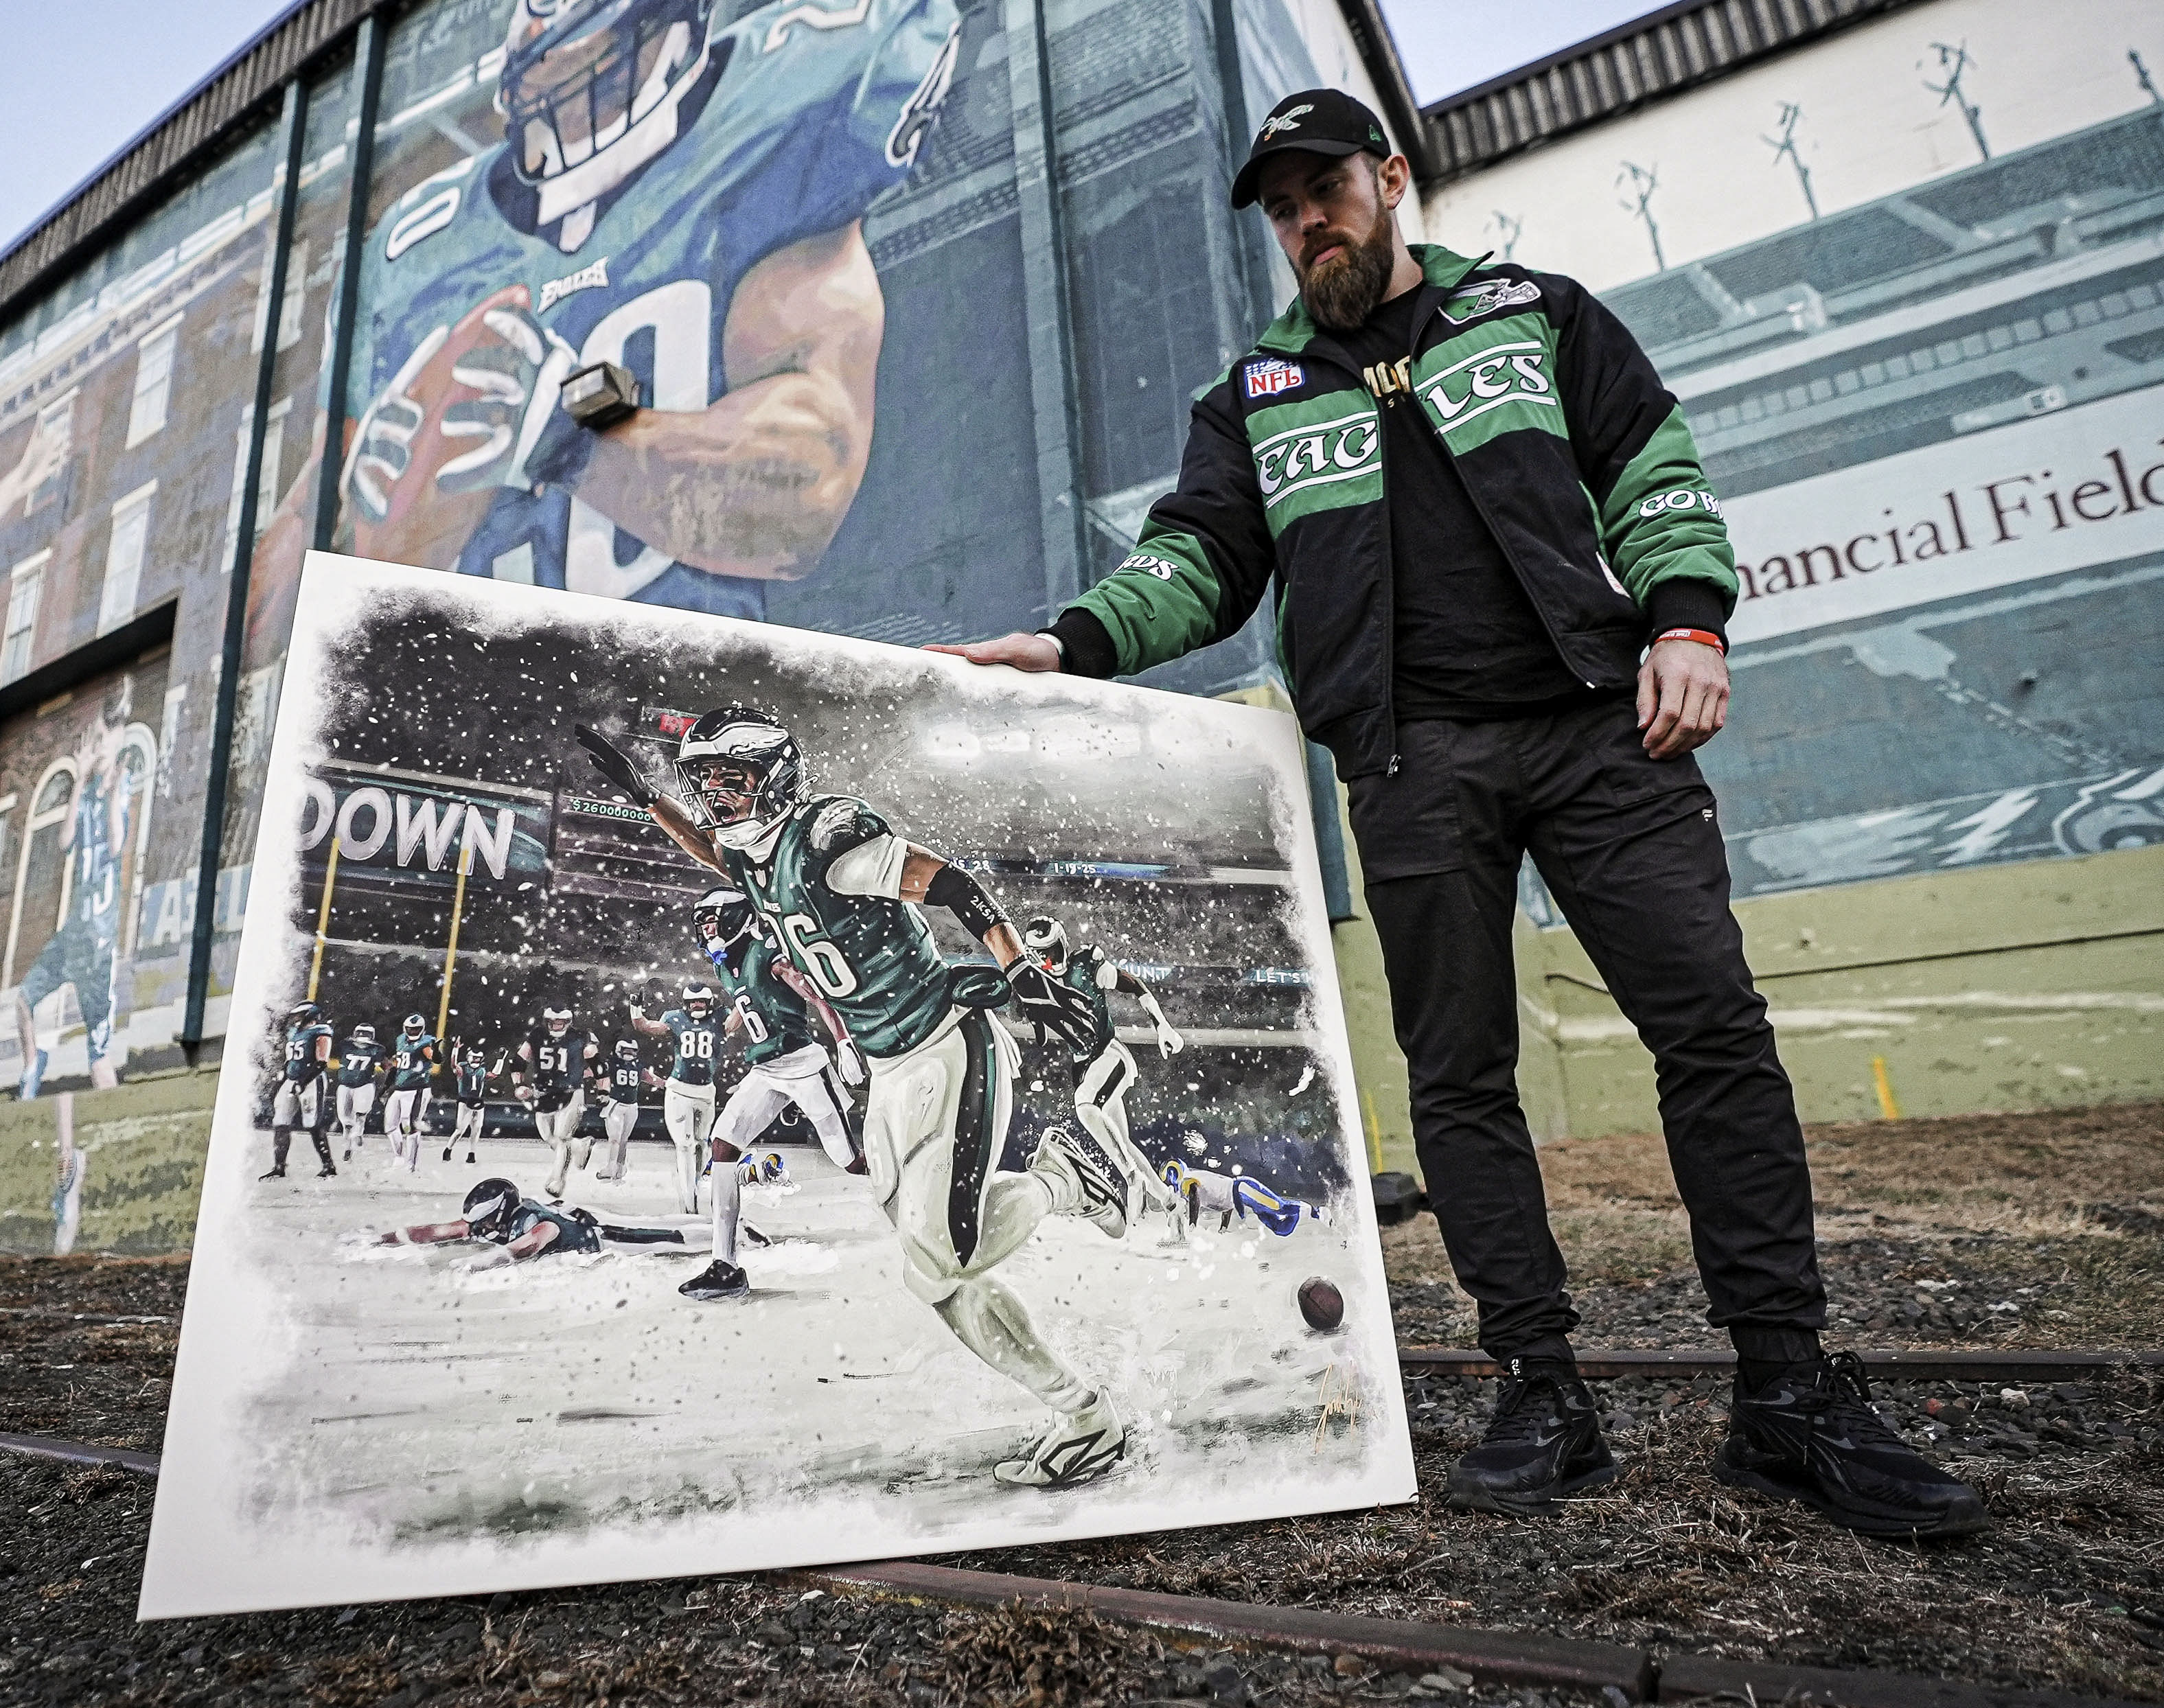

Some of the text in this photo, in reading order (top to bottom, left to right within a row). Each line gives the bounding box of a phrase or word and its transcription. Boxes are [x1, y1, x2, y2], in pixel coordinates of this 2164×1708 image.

[1250, 368, 1300, 395] NFL
[1639, 489, 1696, 518] GO
[971, 859, 991, 873] 28
[679, 1030, 713, 1059] 88
[345, 1053, 371, 1071] 77
[539, 1047, 568, 1072] 51
[616, 1069, 639, 1087] 69
